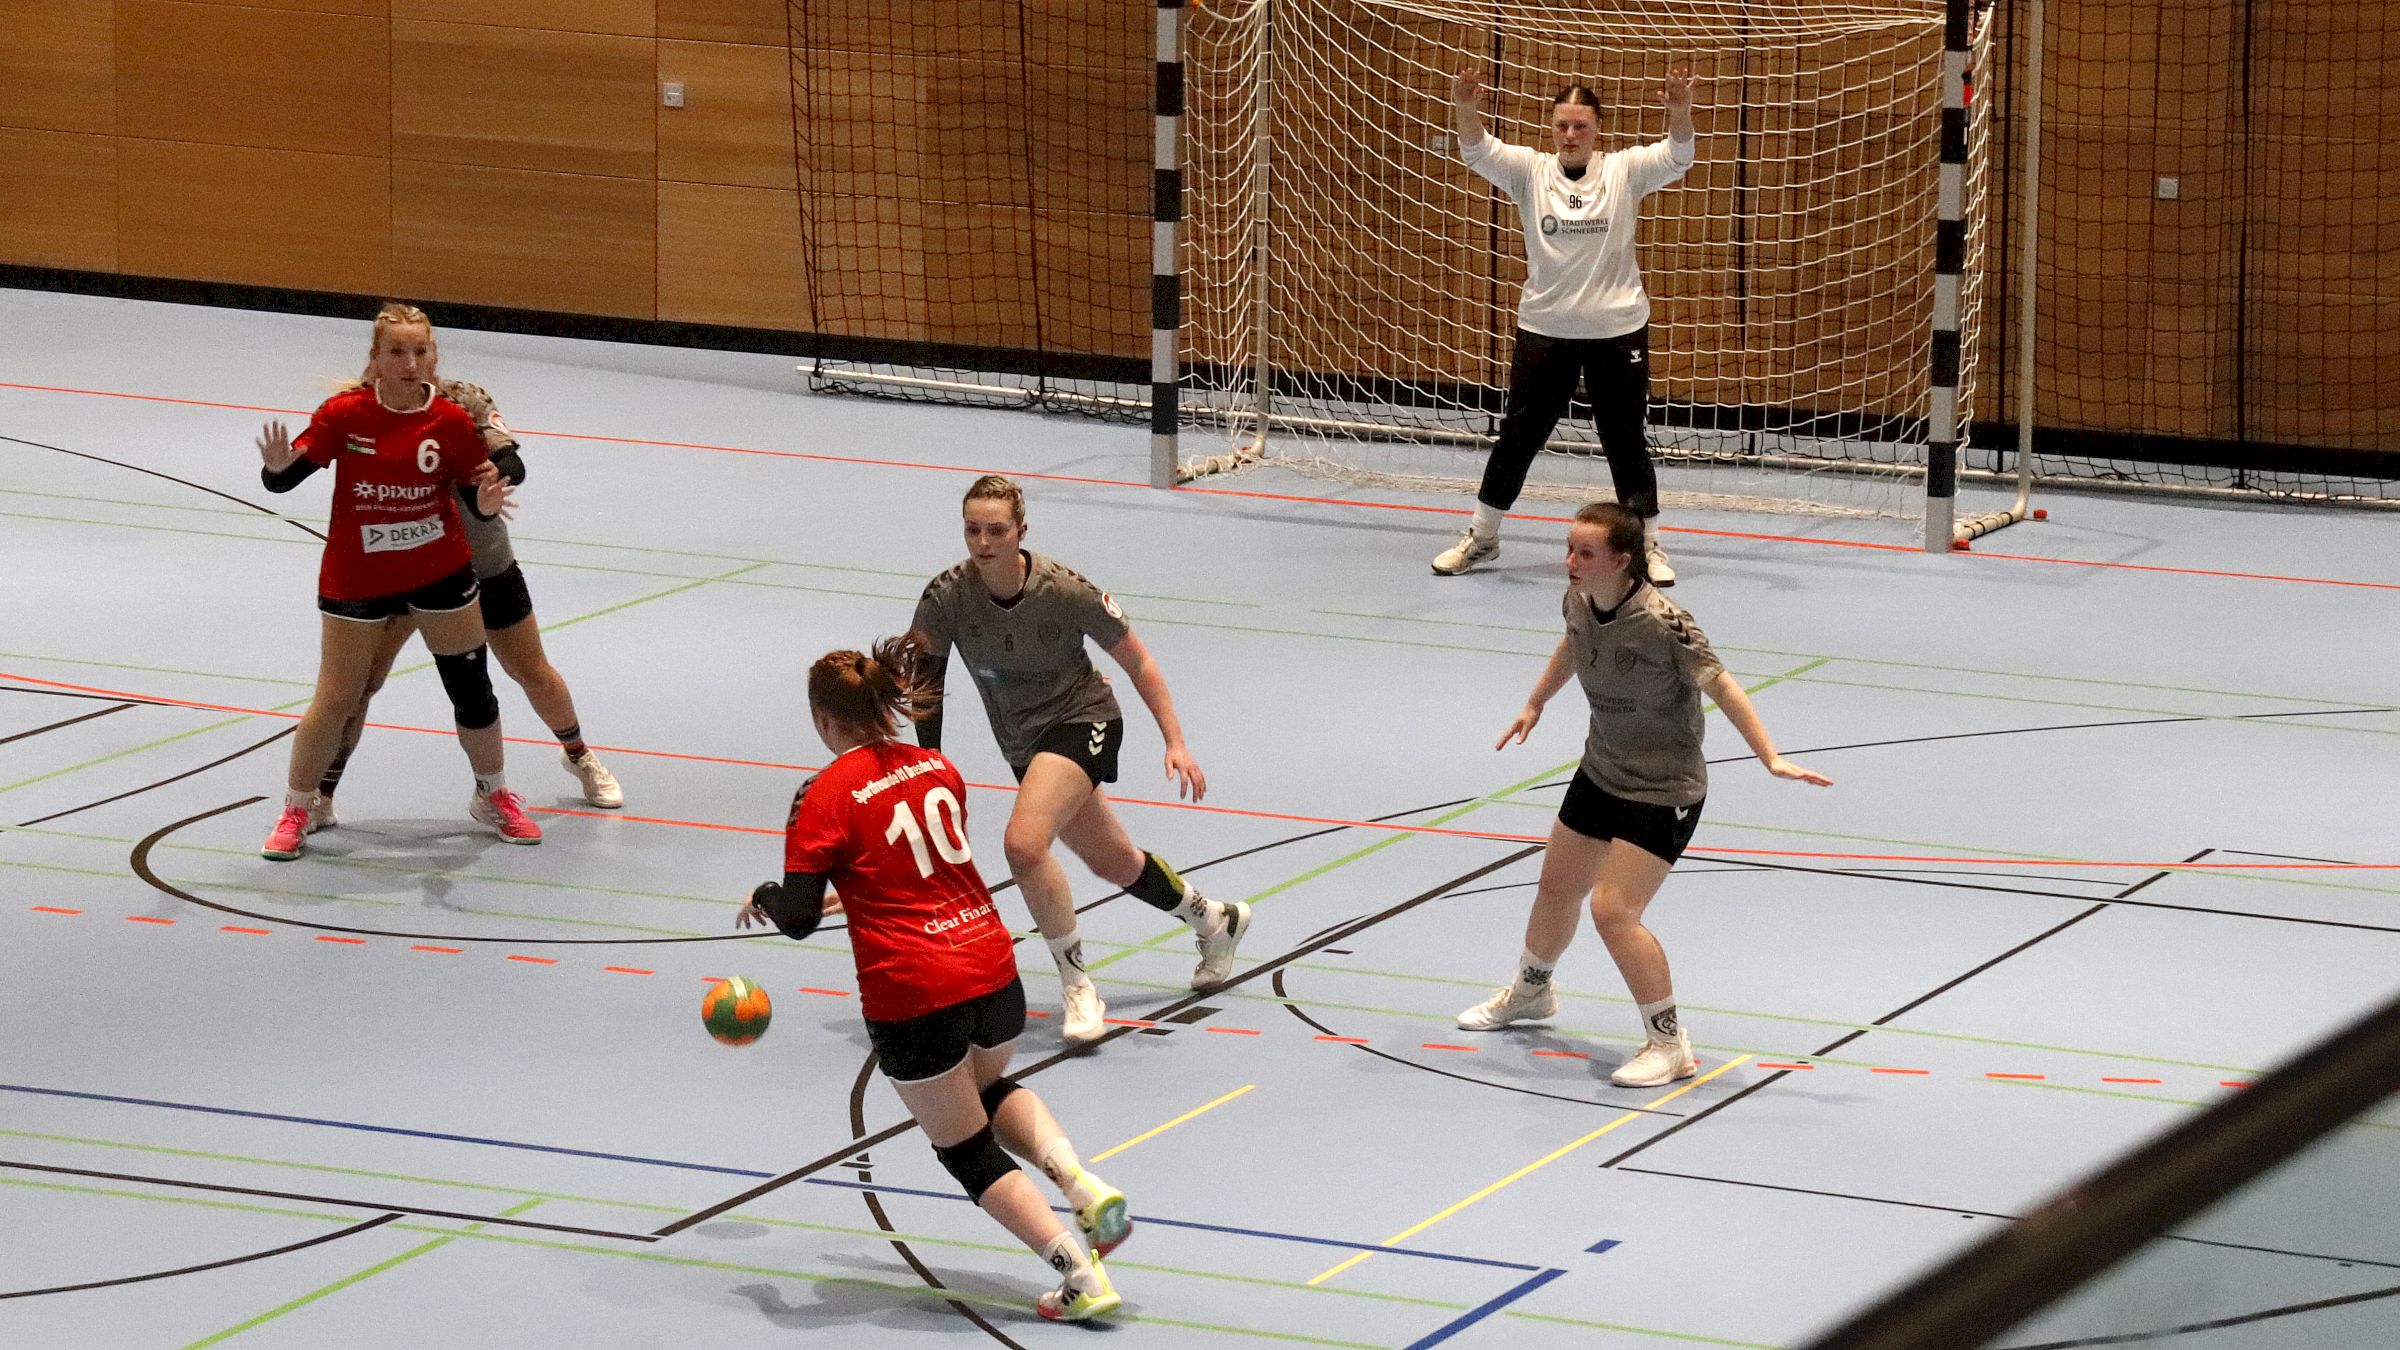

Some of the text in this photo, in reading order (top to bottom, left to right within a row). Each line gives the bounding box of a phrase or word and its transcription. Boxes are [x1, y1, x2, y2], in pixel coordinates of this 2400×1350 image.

[1569, 194, 1582, 209] 96
[1561, 218, 1608, 227] STADTWERKE
[1561, 226, 1609, 235] SCHNEEBERG
[417, 439, 440, 473] 6
[390, 521, 439, 541] DEKRA
[1005, 634, 1013, 651] 6
[1590, 648, 1598, 668] 2
[884, 786, 972, 879] 10
[924, 914, 959, 934] Clear
